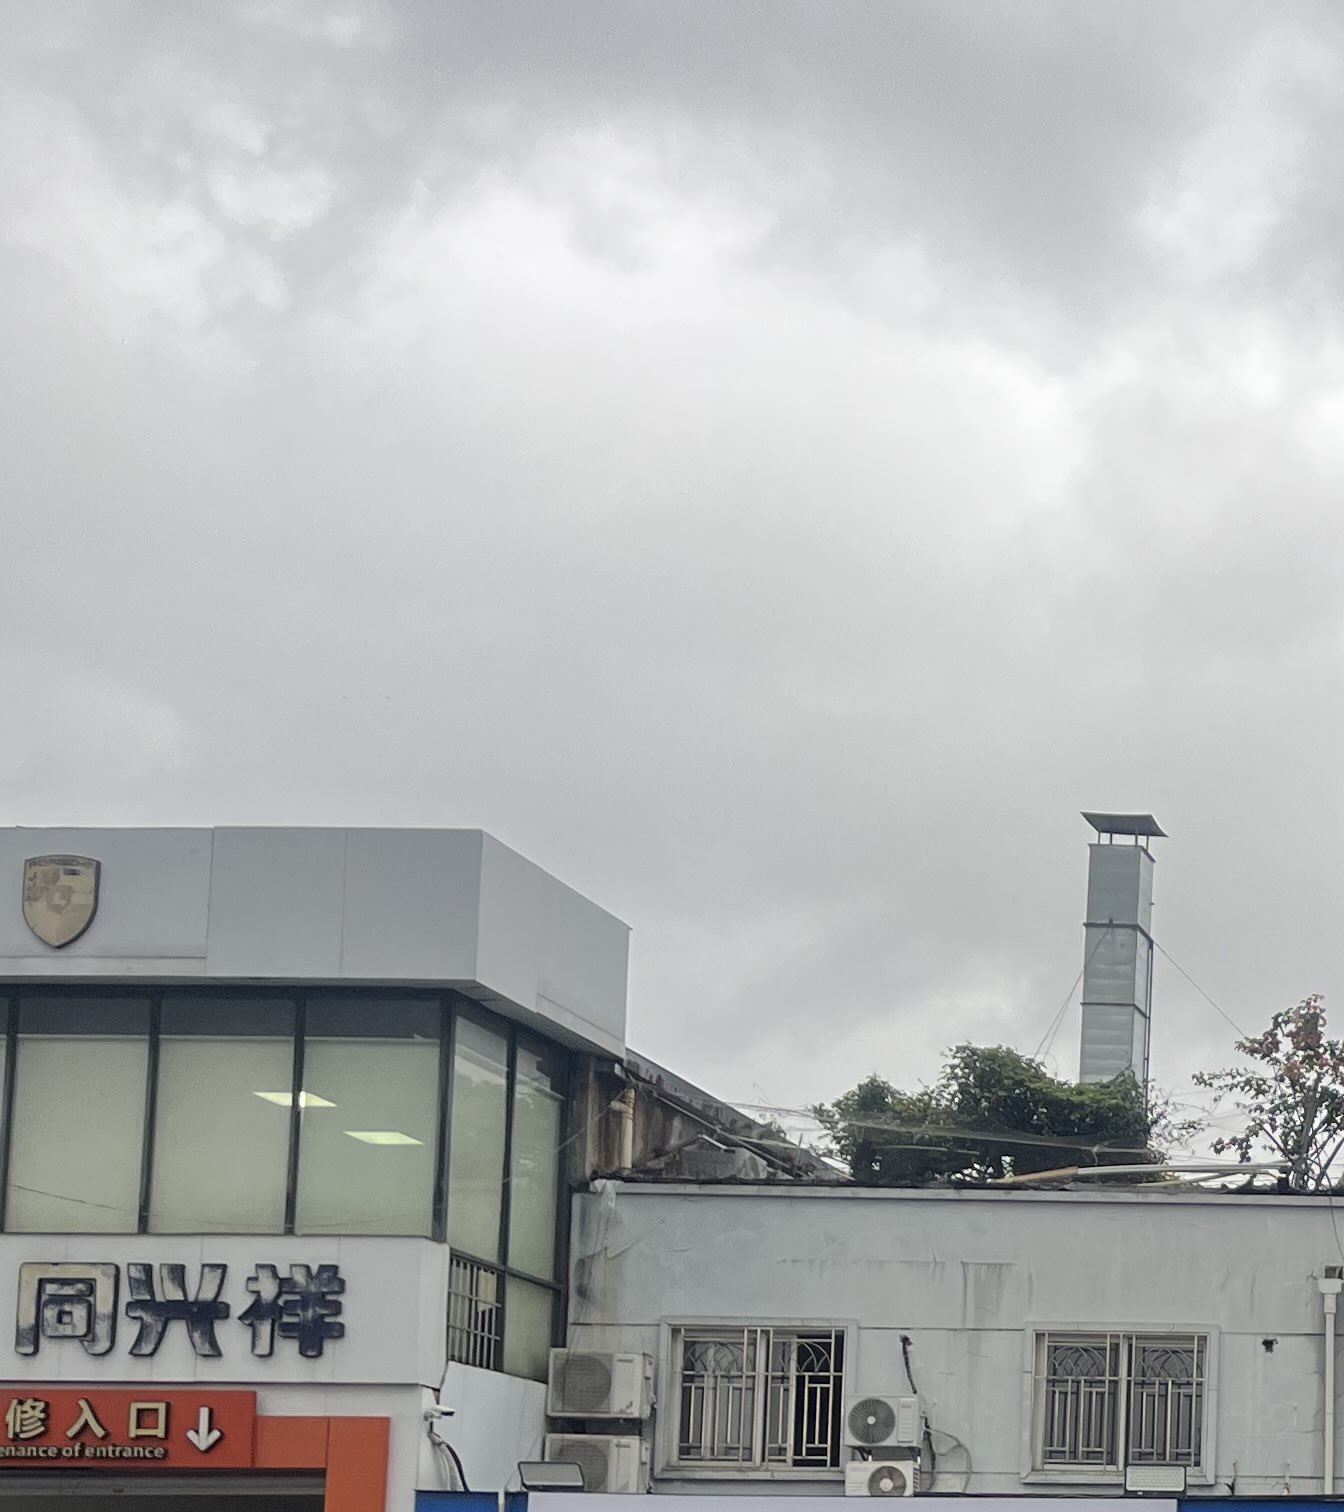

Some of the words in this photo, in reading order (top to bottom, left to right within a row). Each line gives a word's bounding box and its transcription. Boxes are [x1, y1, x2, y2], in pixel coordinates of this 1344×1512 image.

[15, 1262, 346, 1358] 同兴祥
[6, 1398, 168, 1440] 修入口
[62, 1443, 82, 1458] of
[86, 1446, 165, 1459] entrance
